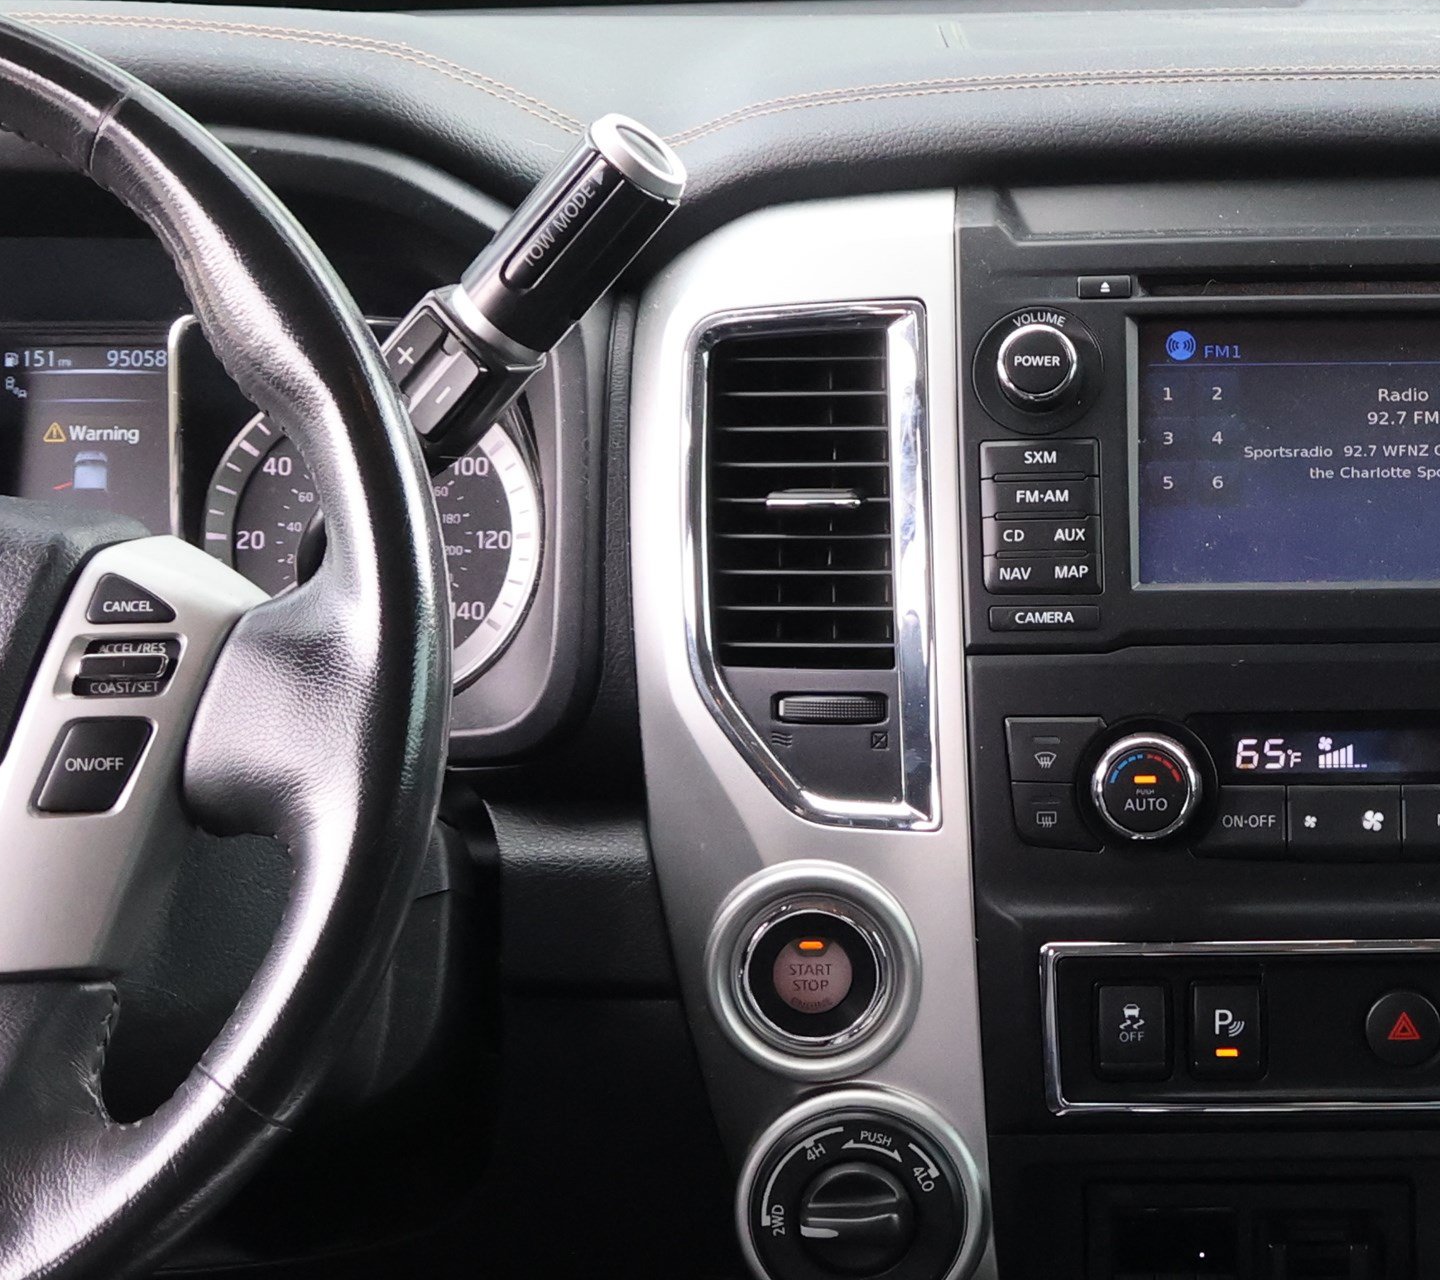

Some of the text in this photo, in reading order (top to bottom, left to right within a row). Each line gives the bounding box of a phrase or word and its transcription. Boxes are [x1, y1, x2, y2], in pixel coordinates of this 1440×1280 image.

[522, 183, 596, 267] TOW MODE
[1012, 312, 1066, 328] VOLUME
[24, 350, 54, 367] 151
[107, 350, 167, 367] 95058
[1204, 344, 1241, 360] FM1
[1014, 355, 1060, 367] POWER
[1163, 387, 1223, 401] 1 2
[1378, 387, 1429, 402] Radio
[1367, 411, 1440, 426] 92.7 FM
[69, 425, 140, 444] Warning
[1163, 431, 1223, 445] 3 4
[1024, 451, 1057, 464] SXM
[1244, 444, 1333, 461] Sportsradio
[1343, 445, 1377, 458] 92.7
[1383, 444, 1430, 458] WFNZ
[262, 457, 293, 476] 40
[1310, 466, 1334, 479] the
[1340, 465, 1411, 480] Charlotte
[1163, 476, 1223, 490] 5 6
[236, 530, 265, 549] 20
[475, 530, 511, 550] 120
[1003, 529, 1025, 542] CD
[1054, 528, 1086, 541] AUX
[999, 567, 1031, 580] NAV
[1054, 565, 1089, 579] MAP
[103, 601, 154, 612] CANCEL
[1014, 610, 1075, 626] CAMERA
[90, 682, 159, 693] COAST/SET
[65, 758, 123, 771] ON/OFF
[1124, 799, 1168, 812] AUTO
[789, 963, 832, 976] START
[792, 979, 830, 992] STOP
[1119, 1031, 1144, 1042] OFF
[860, 1130, 892, 1147] PUSH
[806, 1143, 826, 1161] 4H
[913, 1166, 935, 1193] 4LO
[772, 1204, 785, 1237] 2WD
